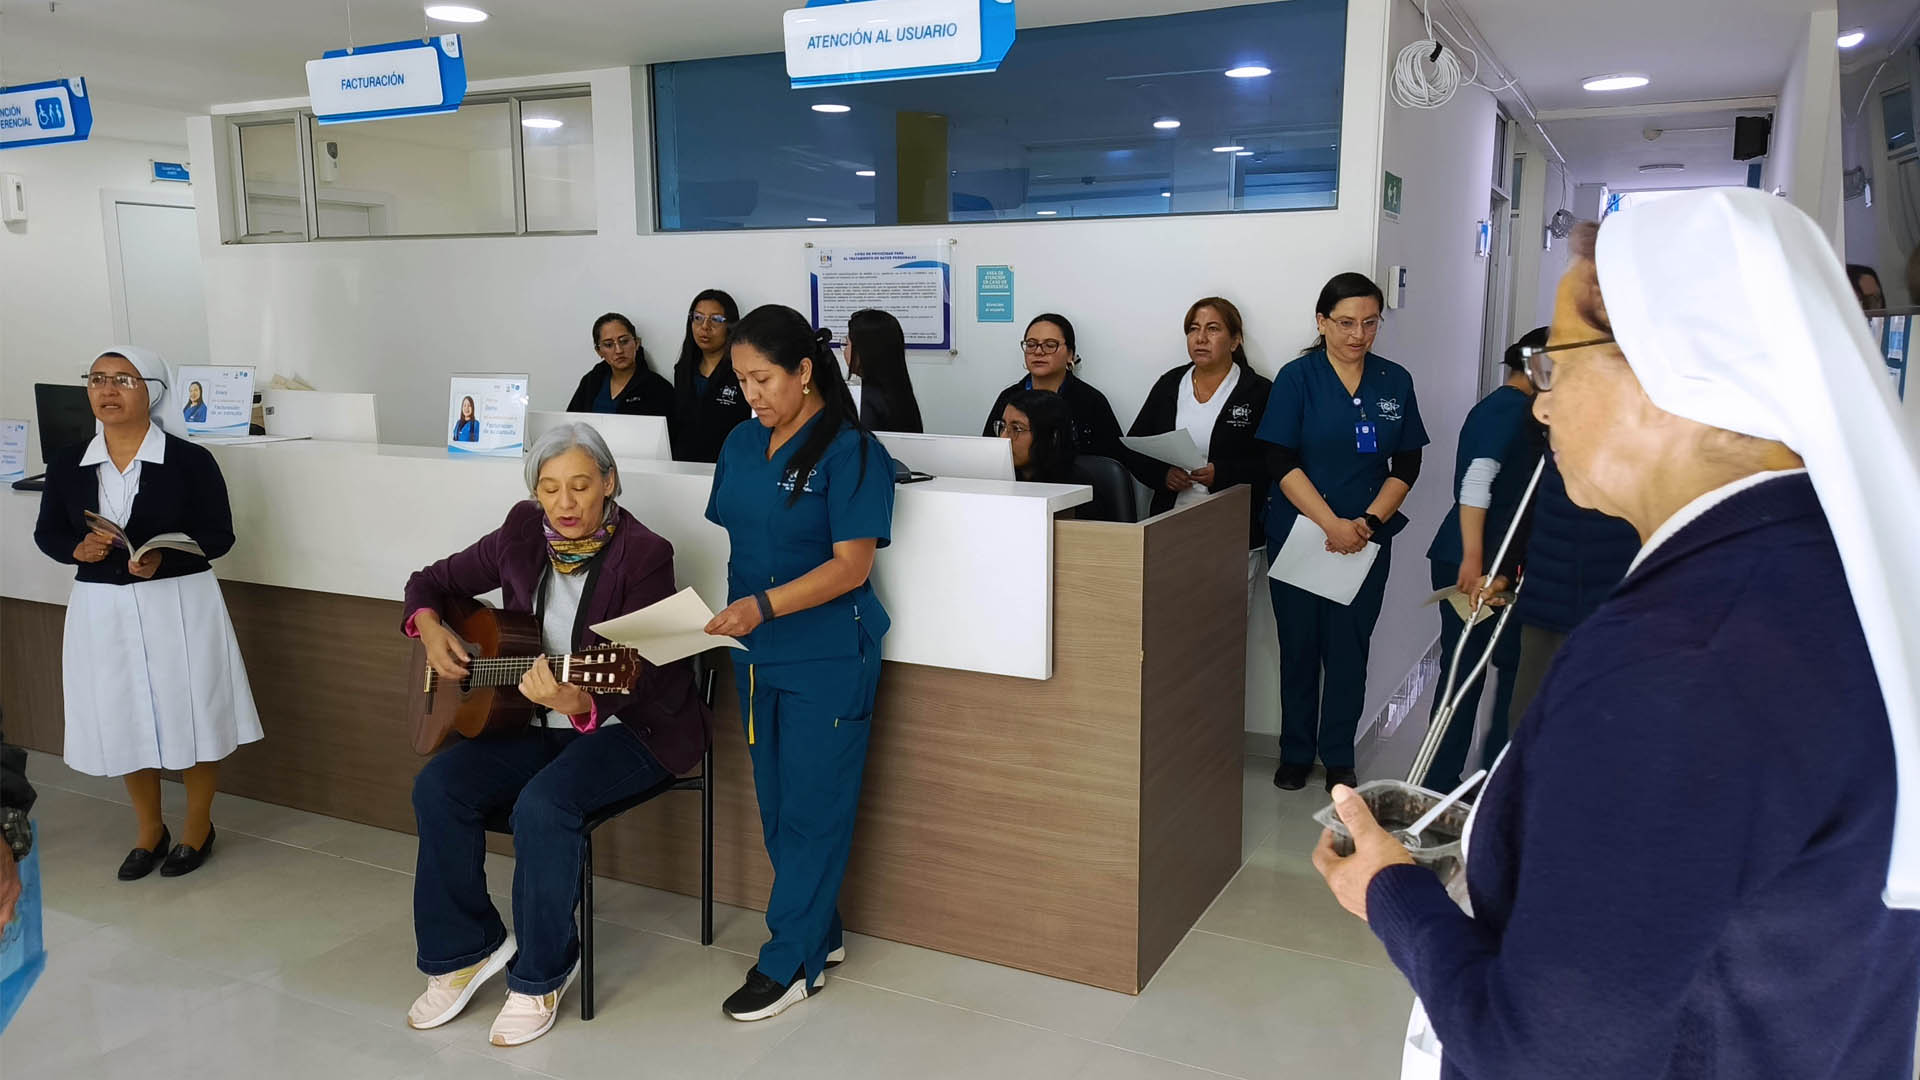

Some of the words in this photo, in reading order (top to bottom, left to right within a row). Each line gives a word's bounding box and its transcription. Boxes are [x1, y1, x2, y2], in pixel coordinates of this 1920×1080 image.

[807, 28, 873, 49] ATENCIÓN
[875, 29, 892, 43] AL
[896, 22, 958, 41] USUARIO
[341, 71, 405, 91] FACTURACIÓN
